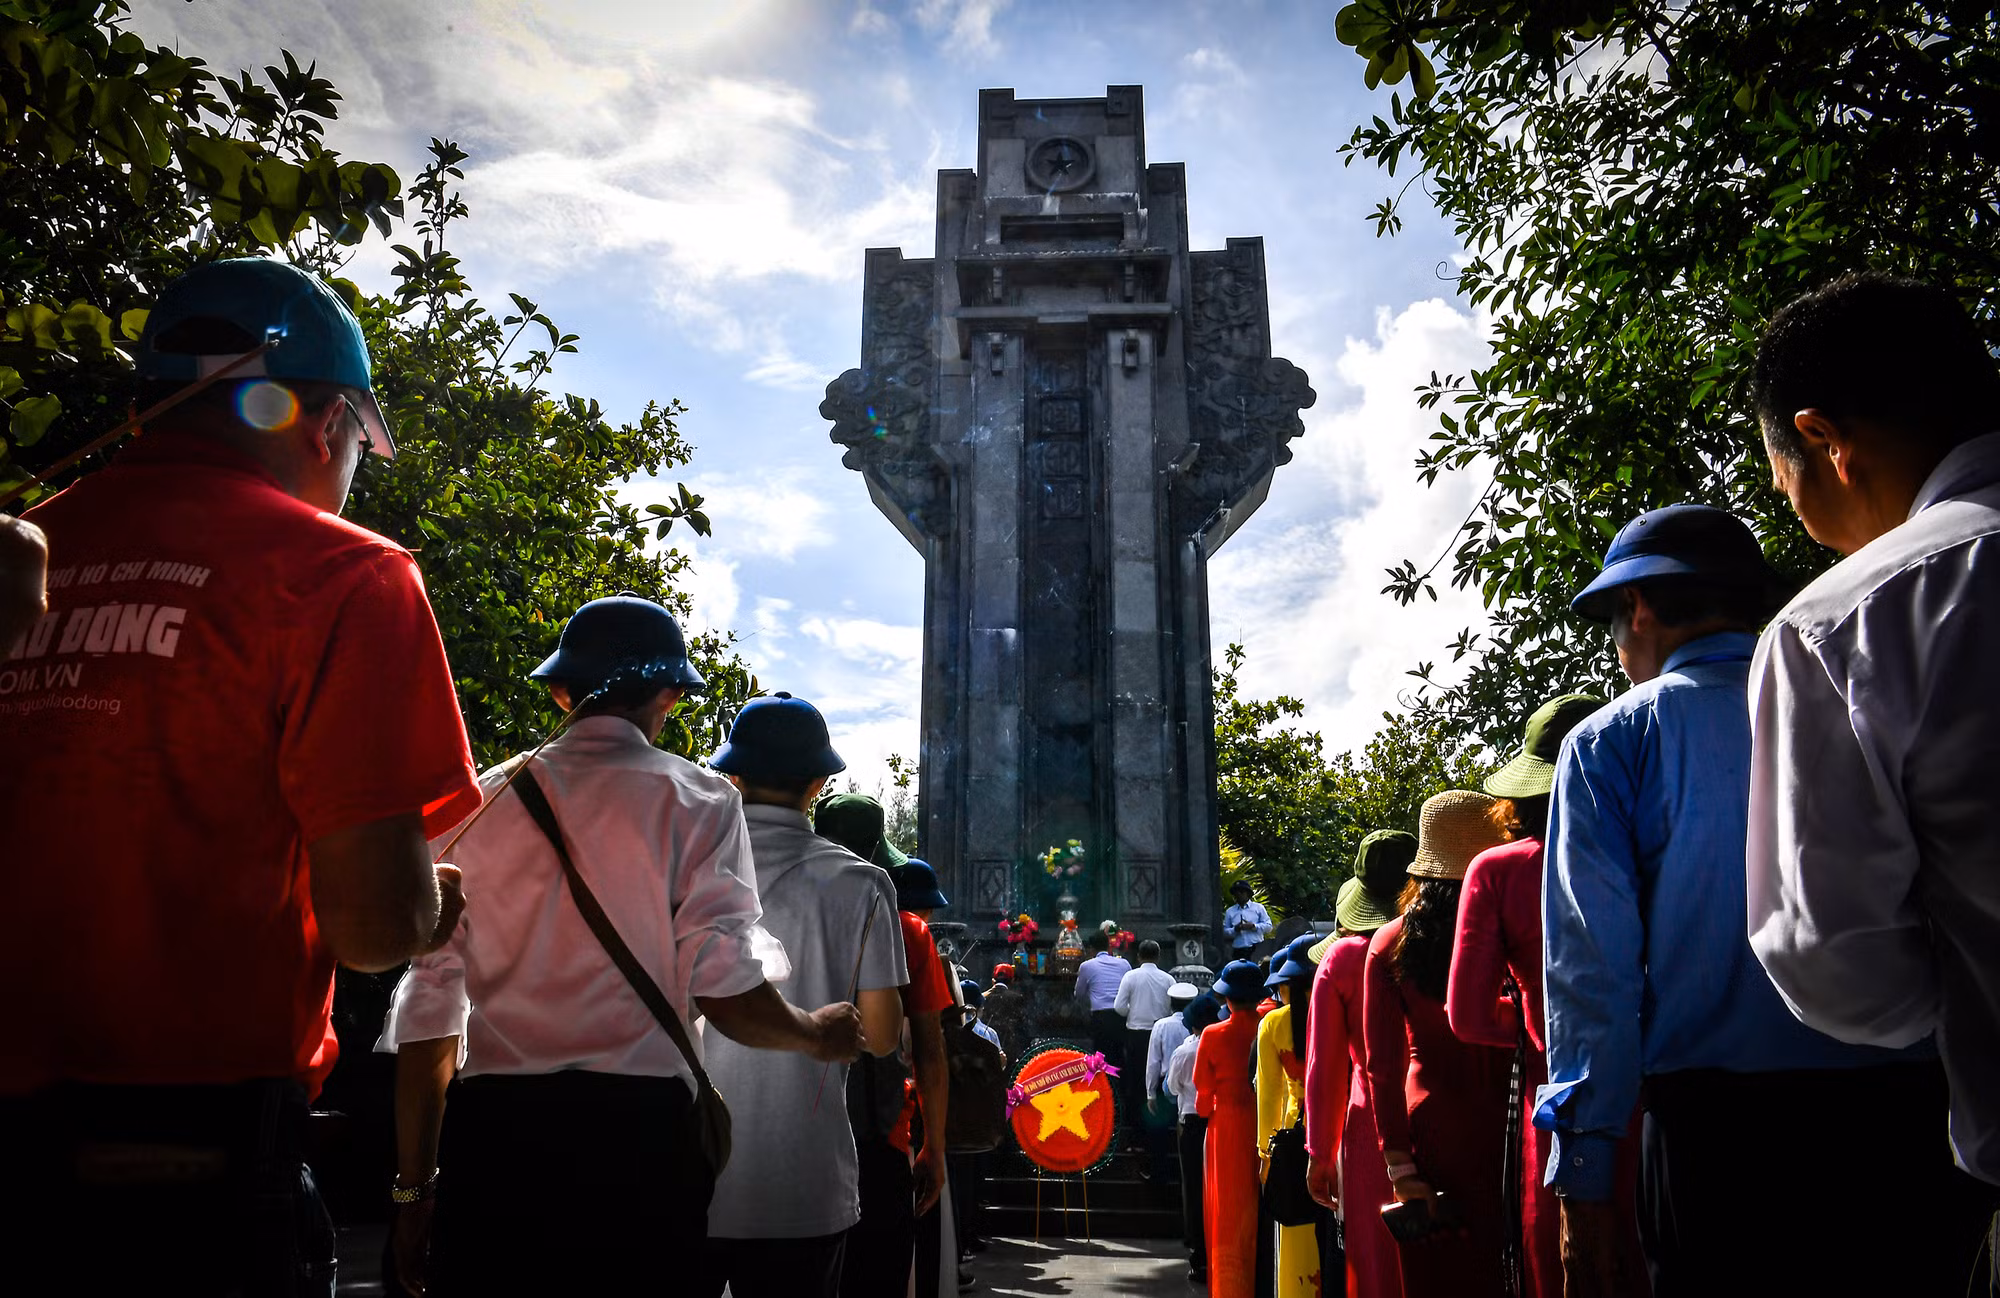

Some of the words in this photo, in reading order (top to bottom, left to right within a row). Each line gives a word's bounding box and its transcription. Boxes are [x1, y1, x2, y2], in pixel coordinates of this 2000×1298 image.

[110, 558, 149, 582] CHÍ
[145, 561, 211, 587] MINH
[57, 600, 188, 659] ĐỘNG
[0, 662, 84, 695] OM.VN
